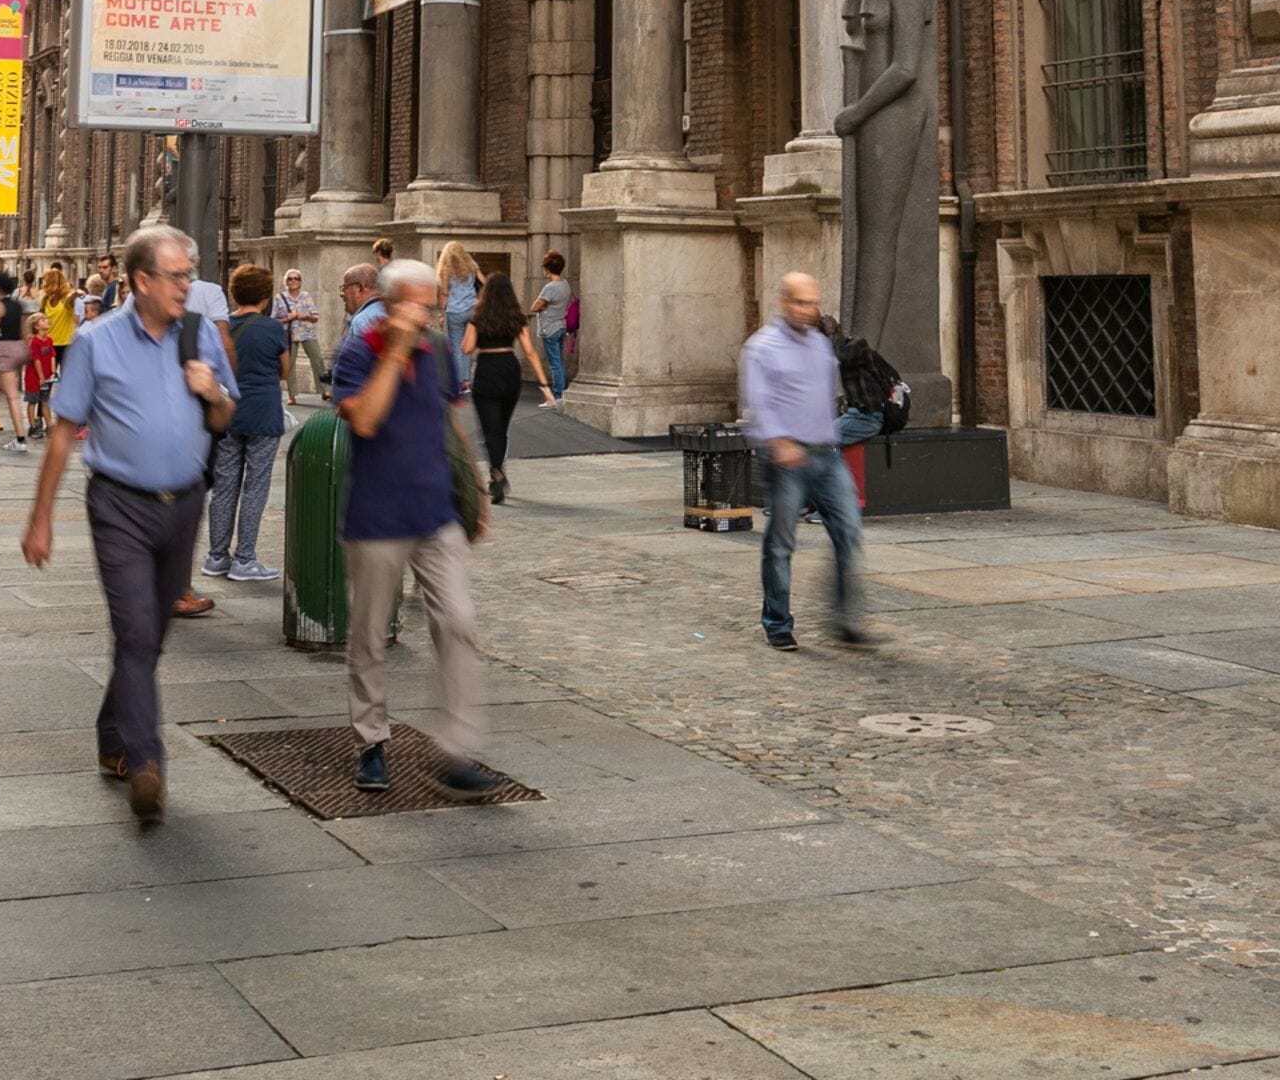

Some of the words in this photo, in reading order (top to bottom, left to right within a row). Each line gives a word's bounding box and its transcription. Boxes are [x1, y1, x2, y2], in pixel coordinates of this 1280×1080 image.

[105, 13, 160, 29] COME
[169, 17, 222, 32] ARTE
[104, 39, 150, 52] 18.07.2018
[158, 42, 205, 54] 24.02.2019
[103, 52, 133, 64] REGGIA
[135, 54, 145, 64] DI
[4, 72, 19, 128] EGIZIO
